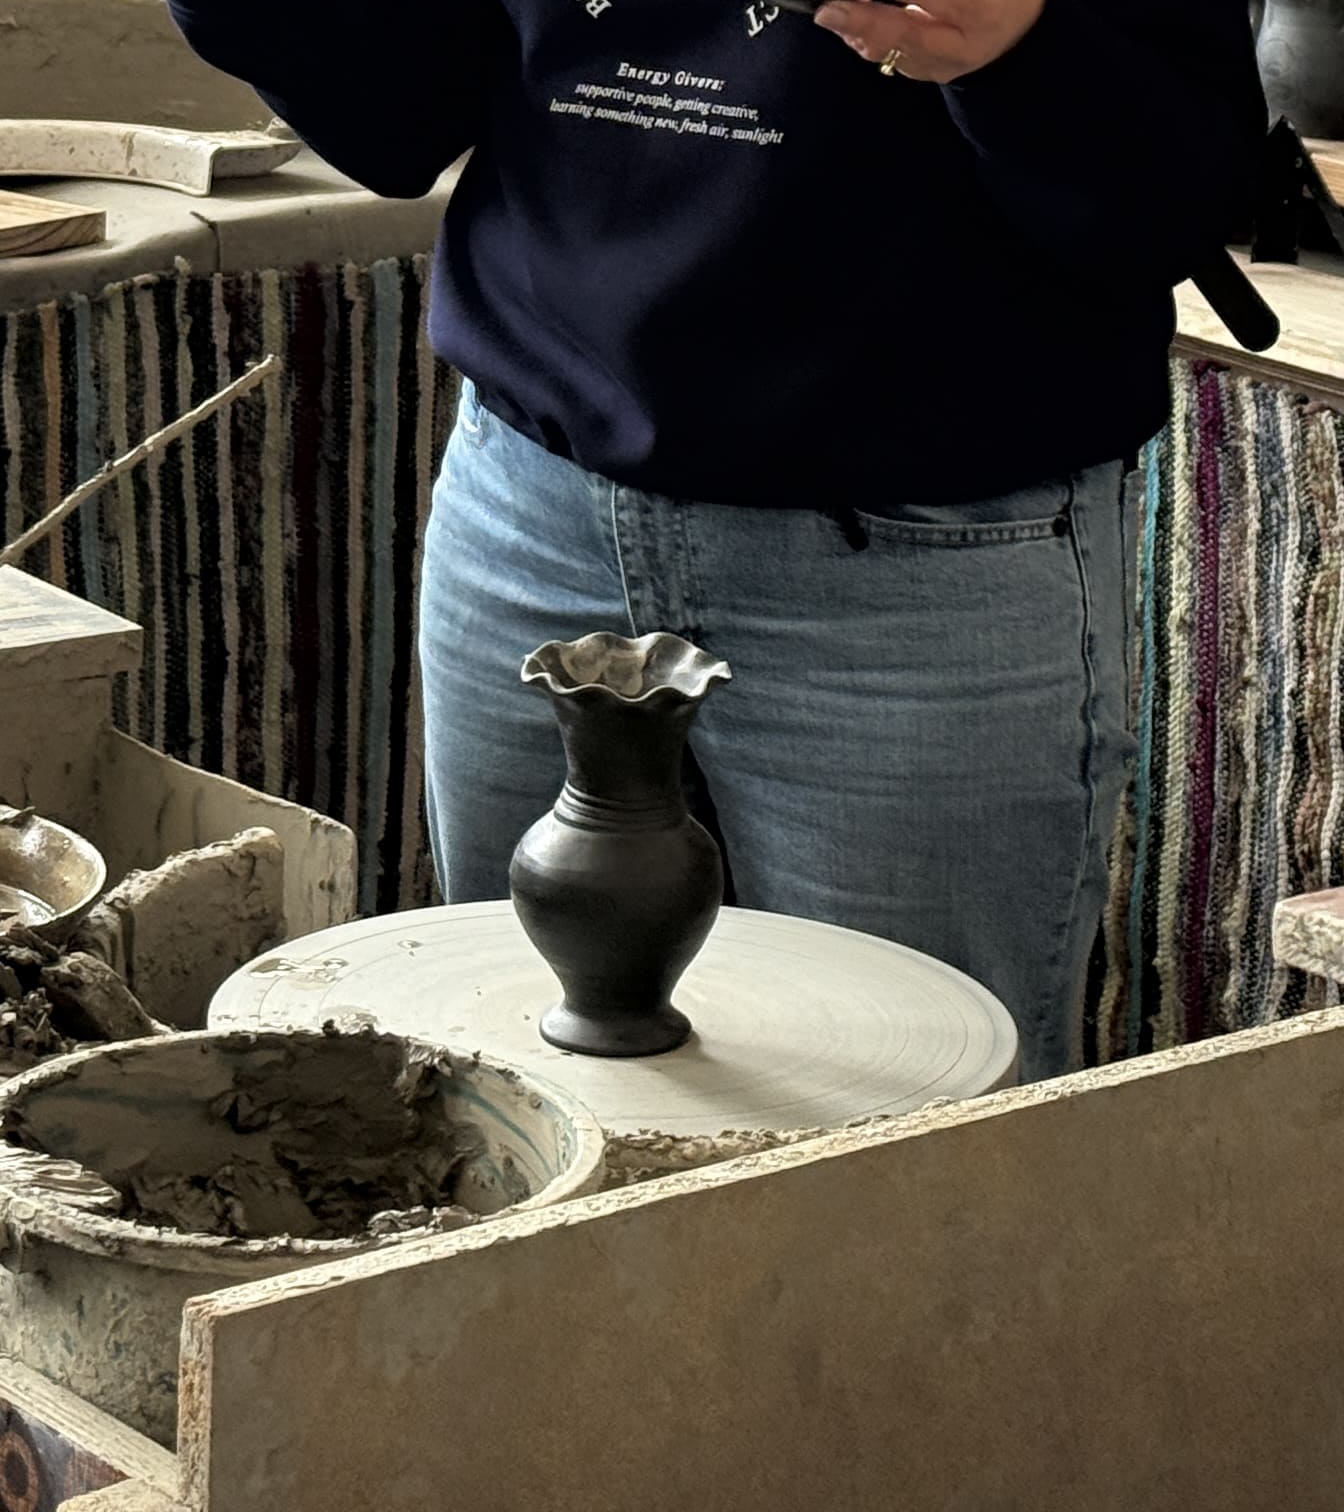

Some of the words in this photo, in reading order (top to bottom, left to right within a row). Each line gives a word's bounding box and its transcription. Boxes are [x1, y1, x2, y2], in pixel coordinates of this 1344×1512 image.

[617, 62, 671, 86] Energy
[674, 71, 726, 91] Givers:
[575, 83, 635, 102] supportive
[673, 98, 711, 115] getting
[549, 98, 594, 119] learning
[594, 108, 655, 129] something
[677, 118, 708, 134] fresh
[731, 128, 784, 145] sunlight
